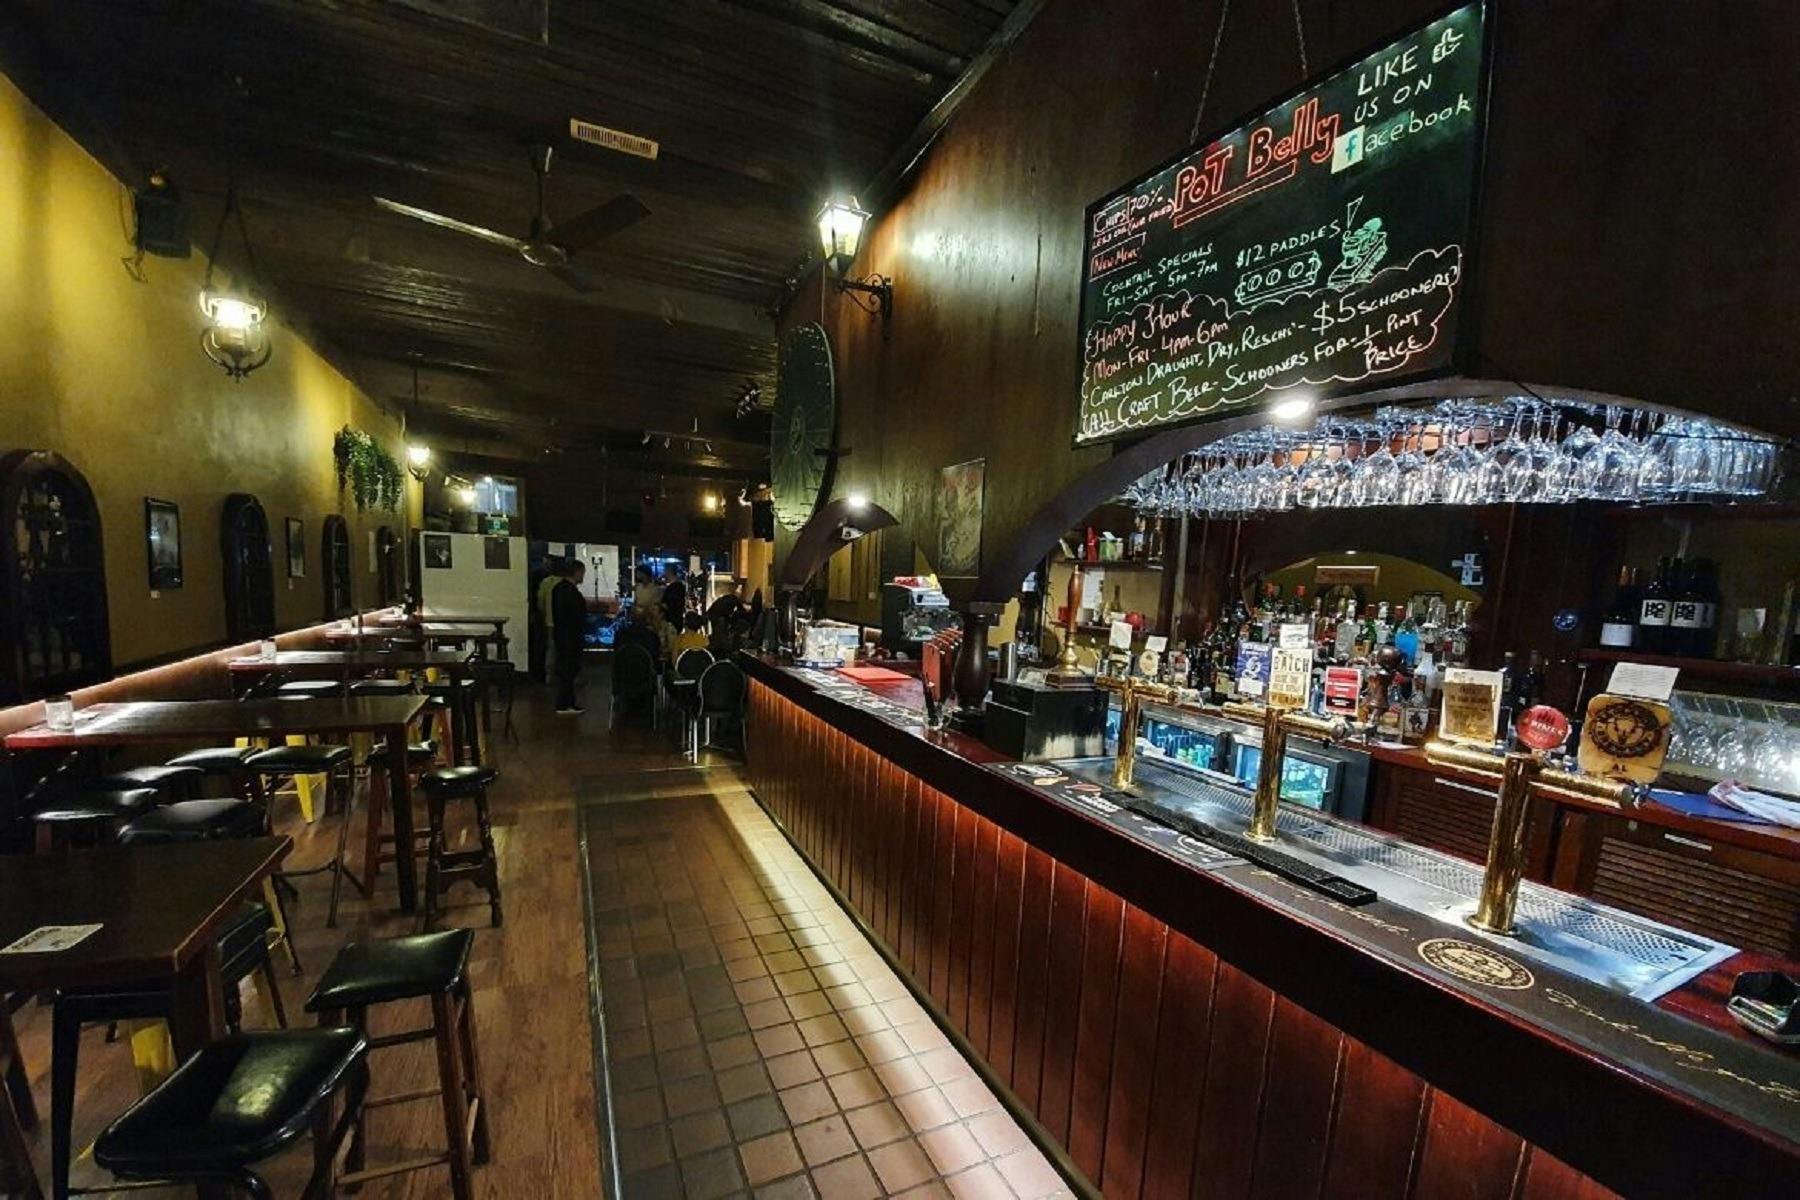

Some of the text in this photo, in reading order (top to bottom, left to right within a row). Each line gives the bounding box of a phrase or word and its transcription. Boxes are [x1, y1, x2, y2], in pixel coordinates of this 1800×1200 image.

[1358, 45, 1418, 96] LIKE
[1354, 73, 1432, 123] US ON
[1103, 242, 1213, 296] COCKTAIL SPECIALS
[1235, 219, 1342, 269] $12 PADDLES
[1090, 375, 1143, 407] CARLTON
[1311, 291, 1356, 336] $5
[1364, 335, 1423, 370] PRICE
[1118, 391, 1163, 423] CRAFT
[1221, 351, 1309, 392] SCHOONERS
[1273, 653, 1310, 673] BATCH
